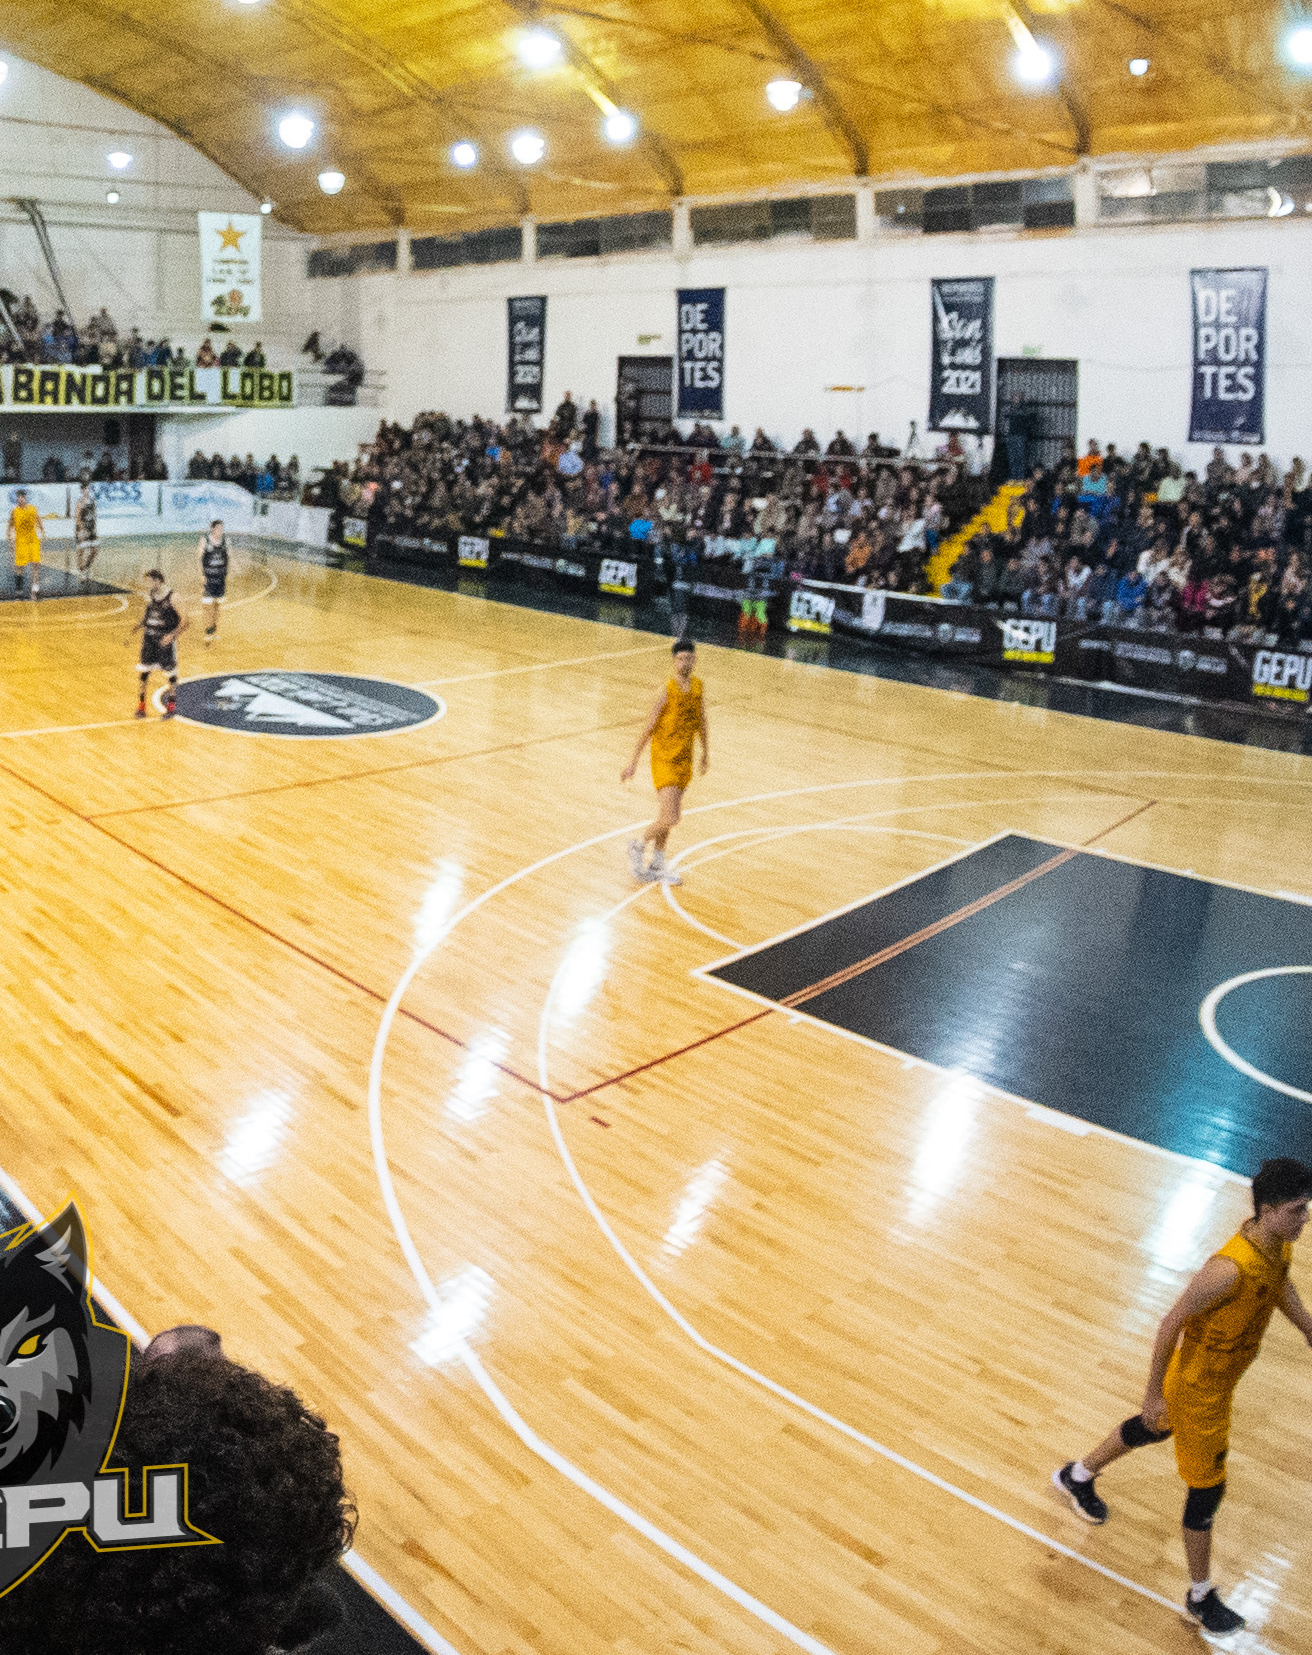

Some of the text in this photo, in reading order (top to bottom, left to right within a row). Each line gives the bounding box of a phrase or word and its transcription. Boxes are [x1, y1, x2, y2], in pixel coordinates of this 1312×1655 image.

[680, 302, 709, 330] DE
[1196, 288, 1237, 324] DE
[681, 331, 722, 358] POR
[1197, 327, 1259, 363] POR
[146, 367, 207, 402] DEL
[221, 369, 293, 406] LOBO
[683, 360, 721, 388] TES
[1196, 365, 1255, 402] TES
[1253, 650, 1312, 690] GEPU
